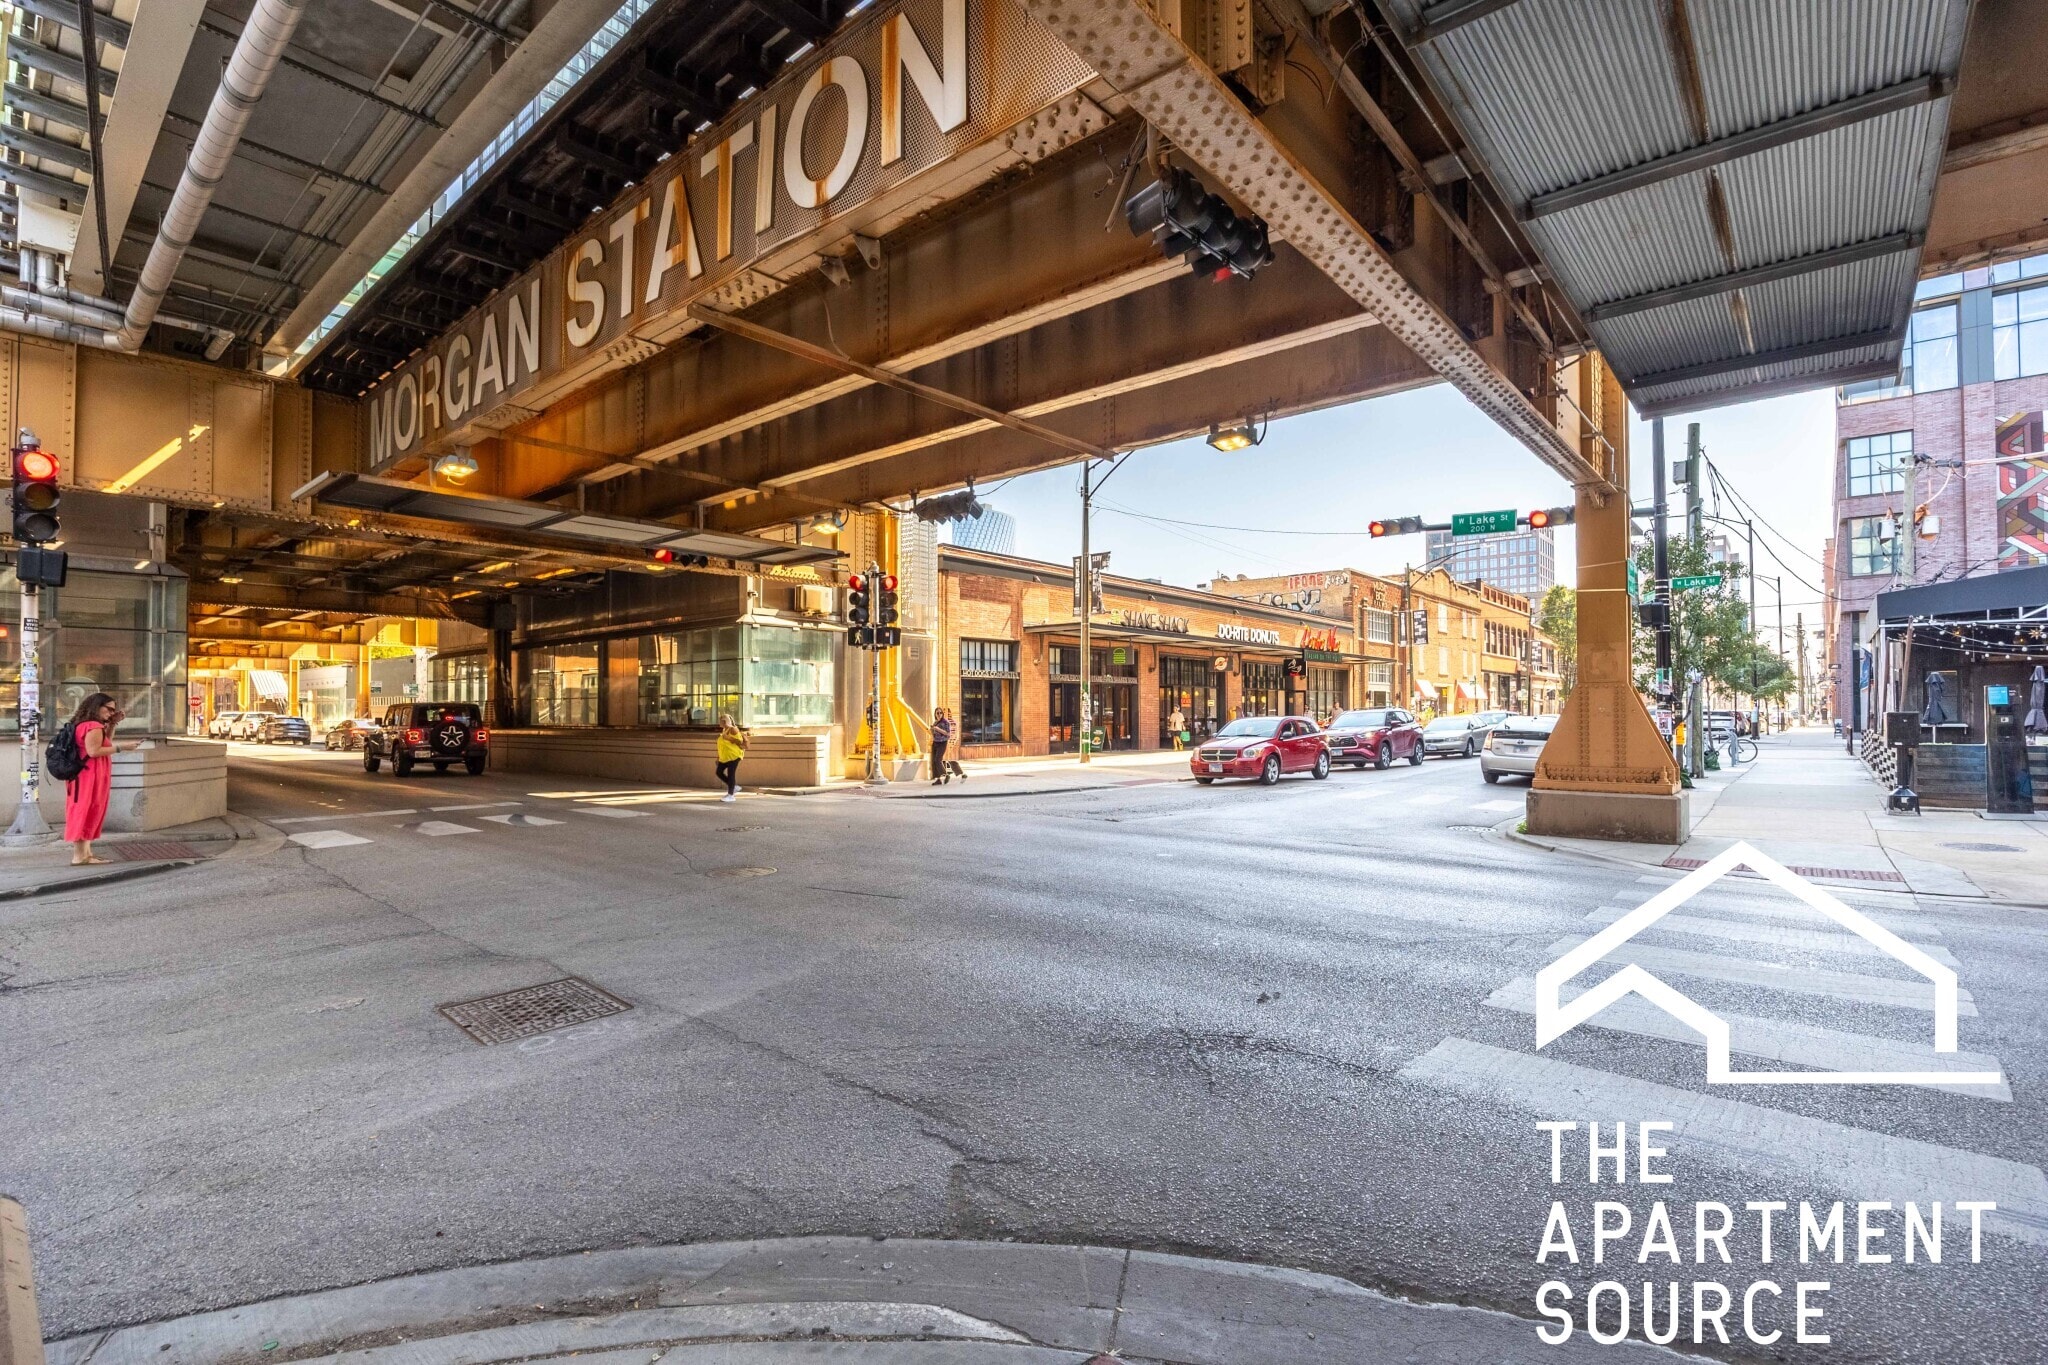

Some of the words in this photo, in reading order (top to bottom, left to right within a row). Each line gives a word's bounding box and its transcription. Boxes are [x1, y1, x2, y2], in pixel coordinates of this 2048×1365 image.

[370, 278, 541, 469] MORGAN
[566, 0, 969, 347] STATION
[1469, 515, 1496, 526] Lake
[1470, 525, 1486, 533] 200
[1684, 577, 1707, 587] Lake
[1123, 609, 1157, 630] SHAKE
[1159, 614, 1190, 633] SHACK
[1218, 623, 1249, 642] DO-RITE
[1250, 627, 1280, 645] DONUTS
[962, 669, 974, 677] HOT
